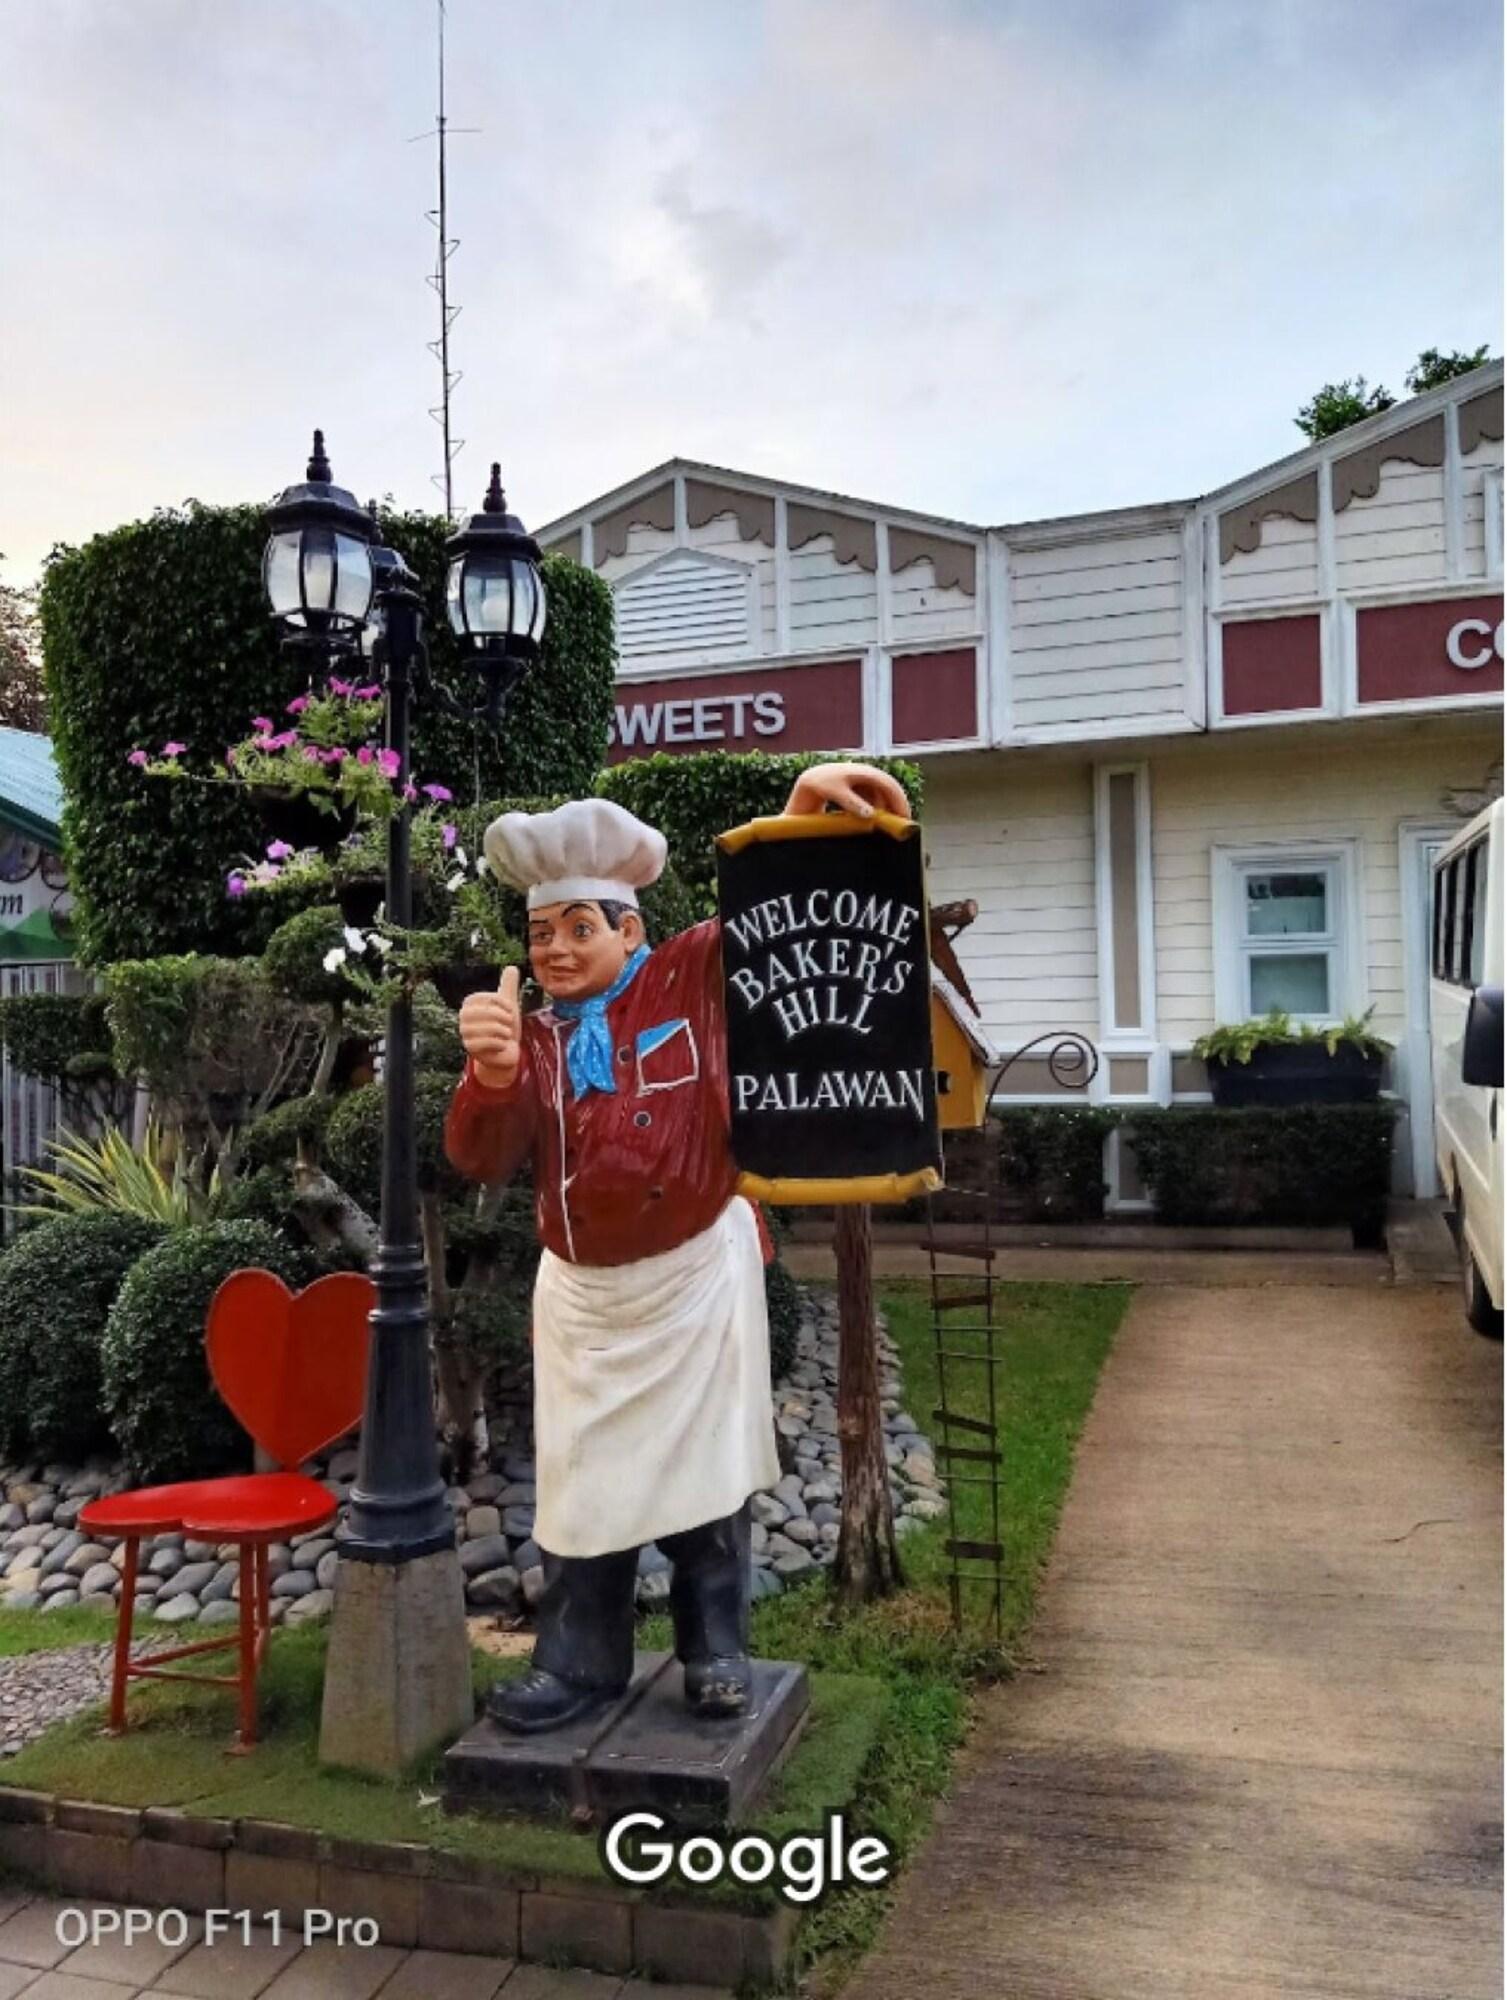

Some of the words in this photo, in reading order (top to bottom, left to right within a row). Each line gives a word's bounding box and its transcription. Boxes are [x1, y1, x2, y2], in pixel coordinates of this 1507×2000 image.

[1446, 619, 1504, 669] C
[607, 692, 786, 746] WEETS
[725, 888, 919, 951] WELCOME
[729, 938, 915, 1010] BAKER'S
[772, 986, 874, 1040] HILL
[734, 1068, 924, 1122] PALAWAN
